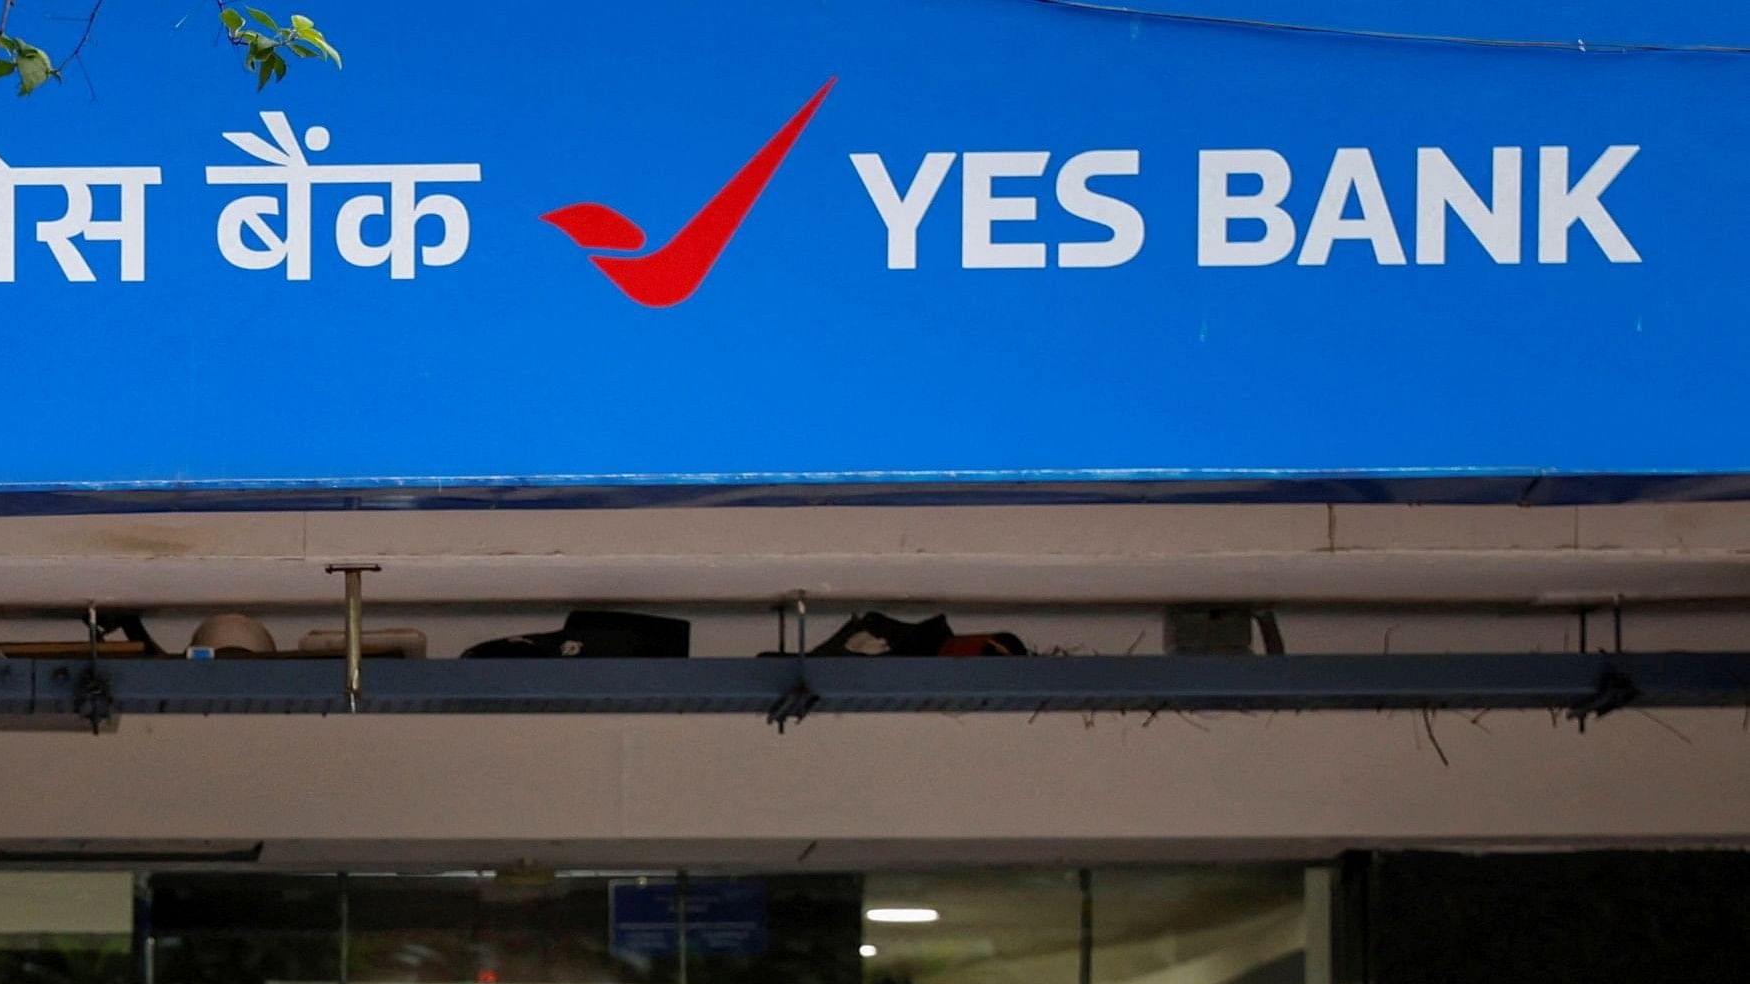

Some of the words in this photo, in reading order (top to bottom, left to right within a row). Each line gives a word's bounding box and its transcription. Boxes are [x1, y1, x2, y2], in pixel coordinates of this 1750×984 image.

[206, 111, 482, 281] बैंक
[850, 149, 1145, 269] YES
[1197, 145, 1642, 267] BANK
